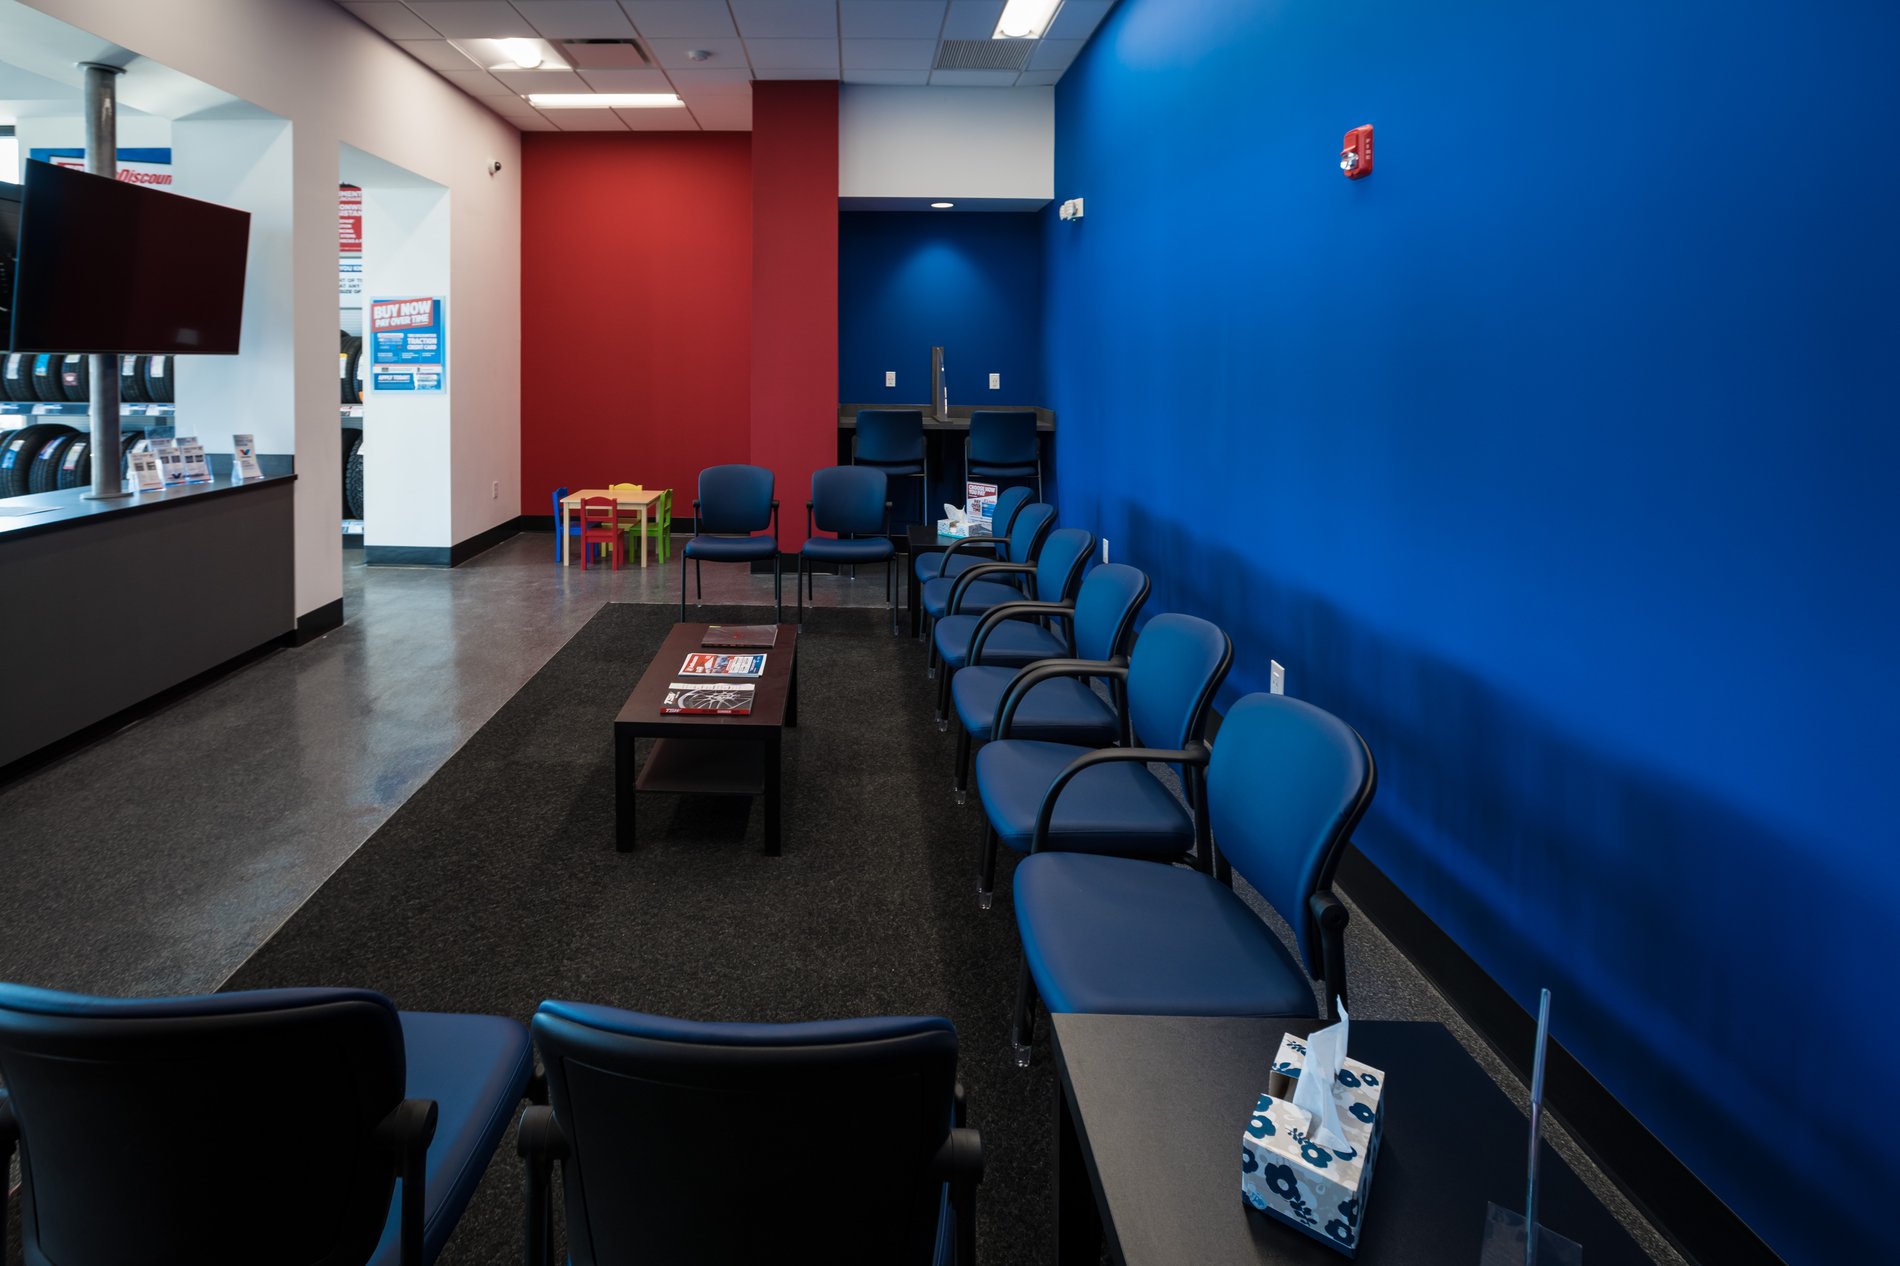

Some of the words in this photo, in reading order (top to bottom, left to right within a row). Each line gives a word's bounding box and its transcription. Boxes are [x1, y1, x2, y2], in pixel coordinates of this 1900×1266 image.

[374, 304, 399, 319] BUY
[400, 300, 431, 316] NOW
[375, 319, 389, 328] PAY
[391, 317, 410, 326] OVER
[411, 314, 429, 324] TIME
